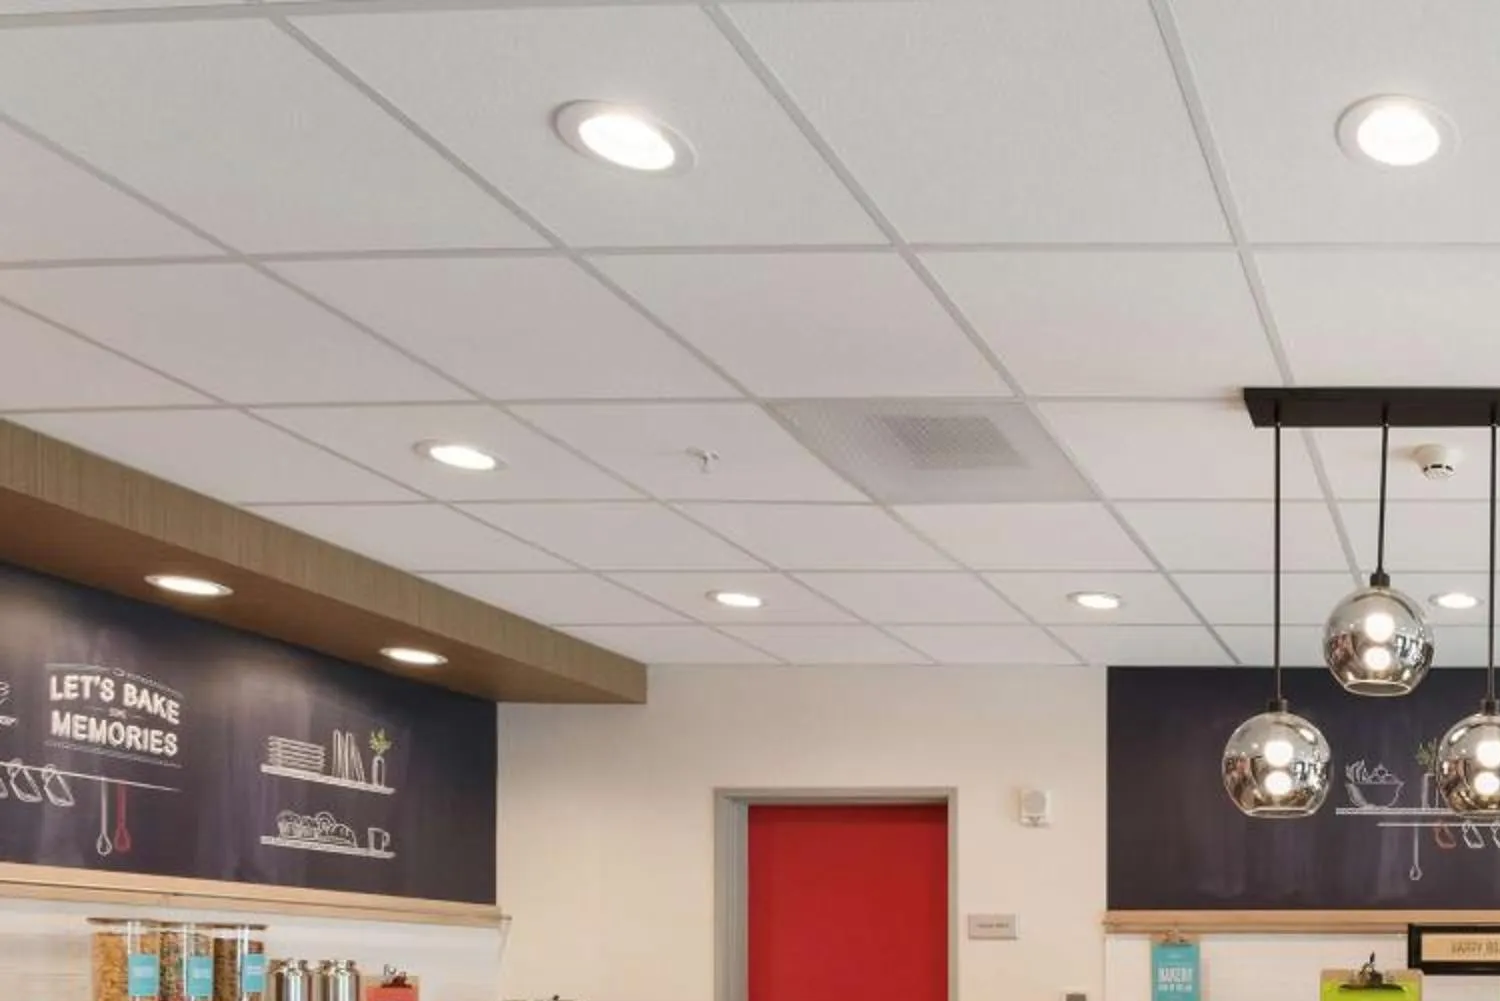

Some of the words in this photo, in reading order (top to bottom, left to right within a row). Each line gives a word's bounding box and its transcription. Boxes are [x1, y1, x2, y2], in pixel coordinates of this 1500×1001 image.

[50, 674, 115, 702] LET'S
[122, 682, 181, 725] BAKE
[50, 709, 178, 757] MEMORIES
